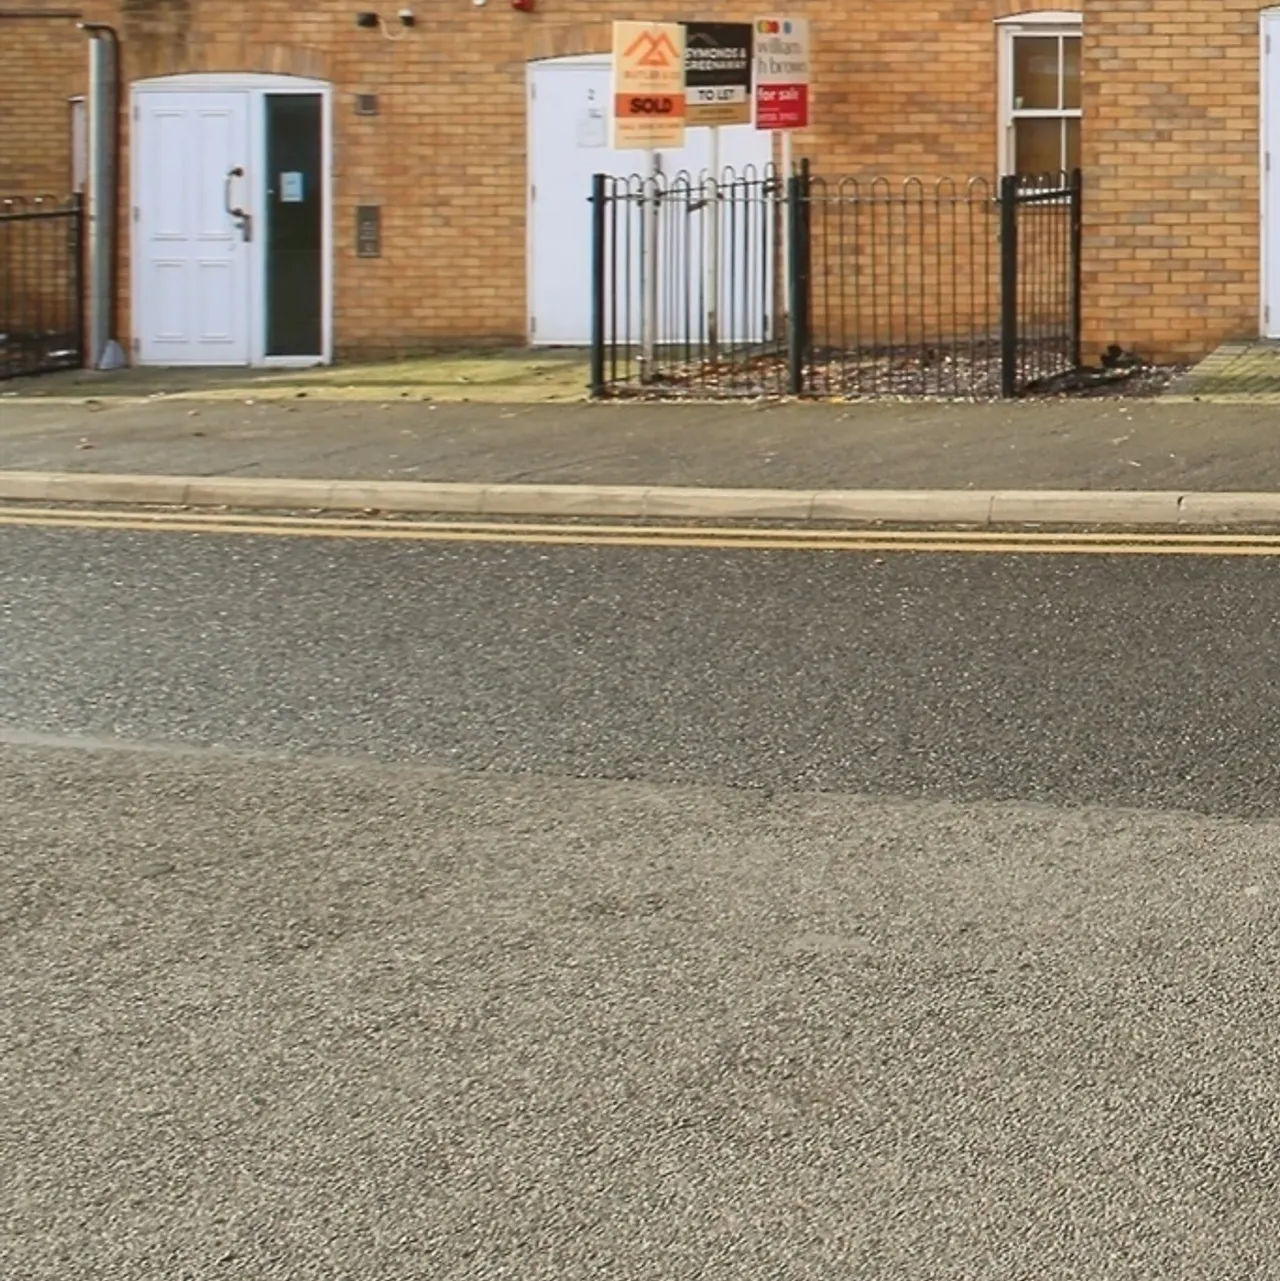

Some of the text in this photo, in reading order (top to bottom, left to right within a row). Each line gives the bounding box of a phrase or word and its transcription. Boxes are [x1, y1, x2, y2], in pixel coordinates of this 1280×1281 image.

[698, 89, 734, 100] TO LET
[758, 86, 799, 100] for sale
[630, 98, 673, 114] SOLD
